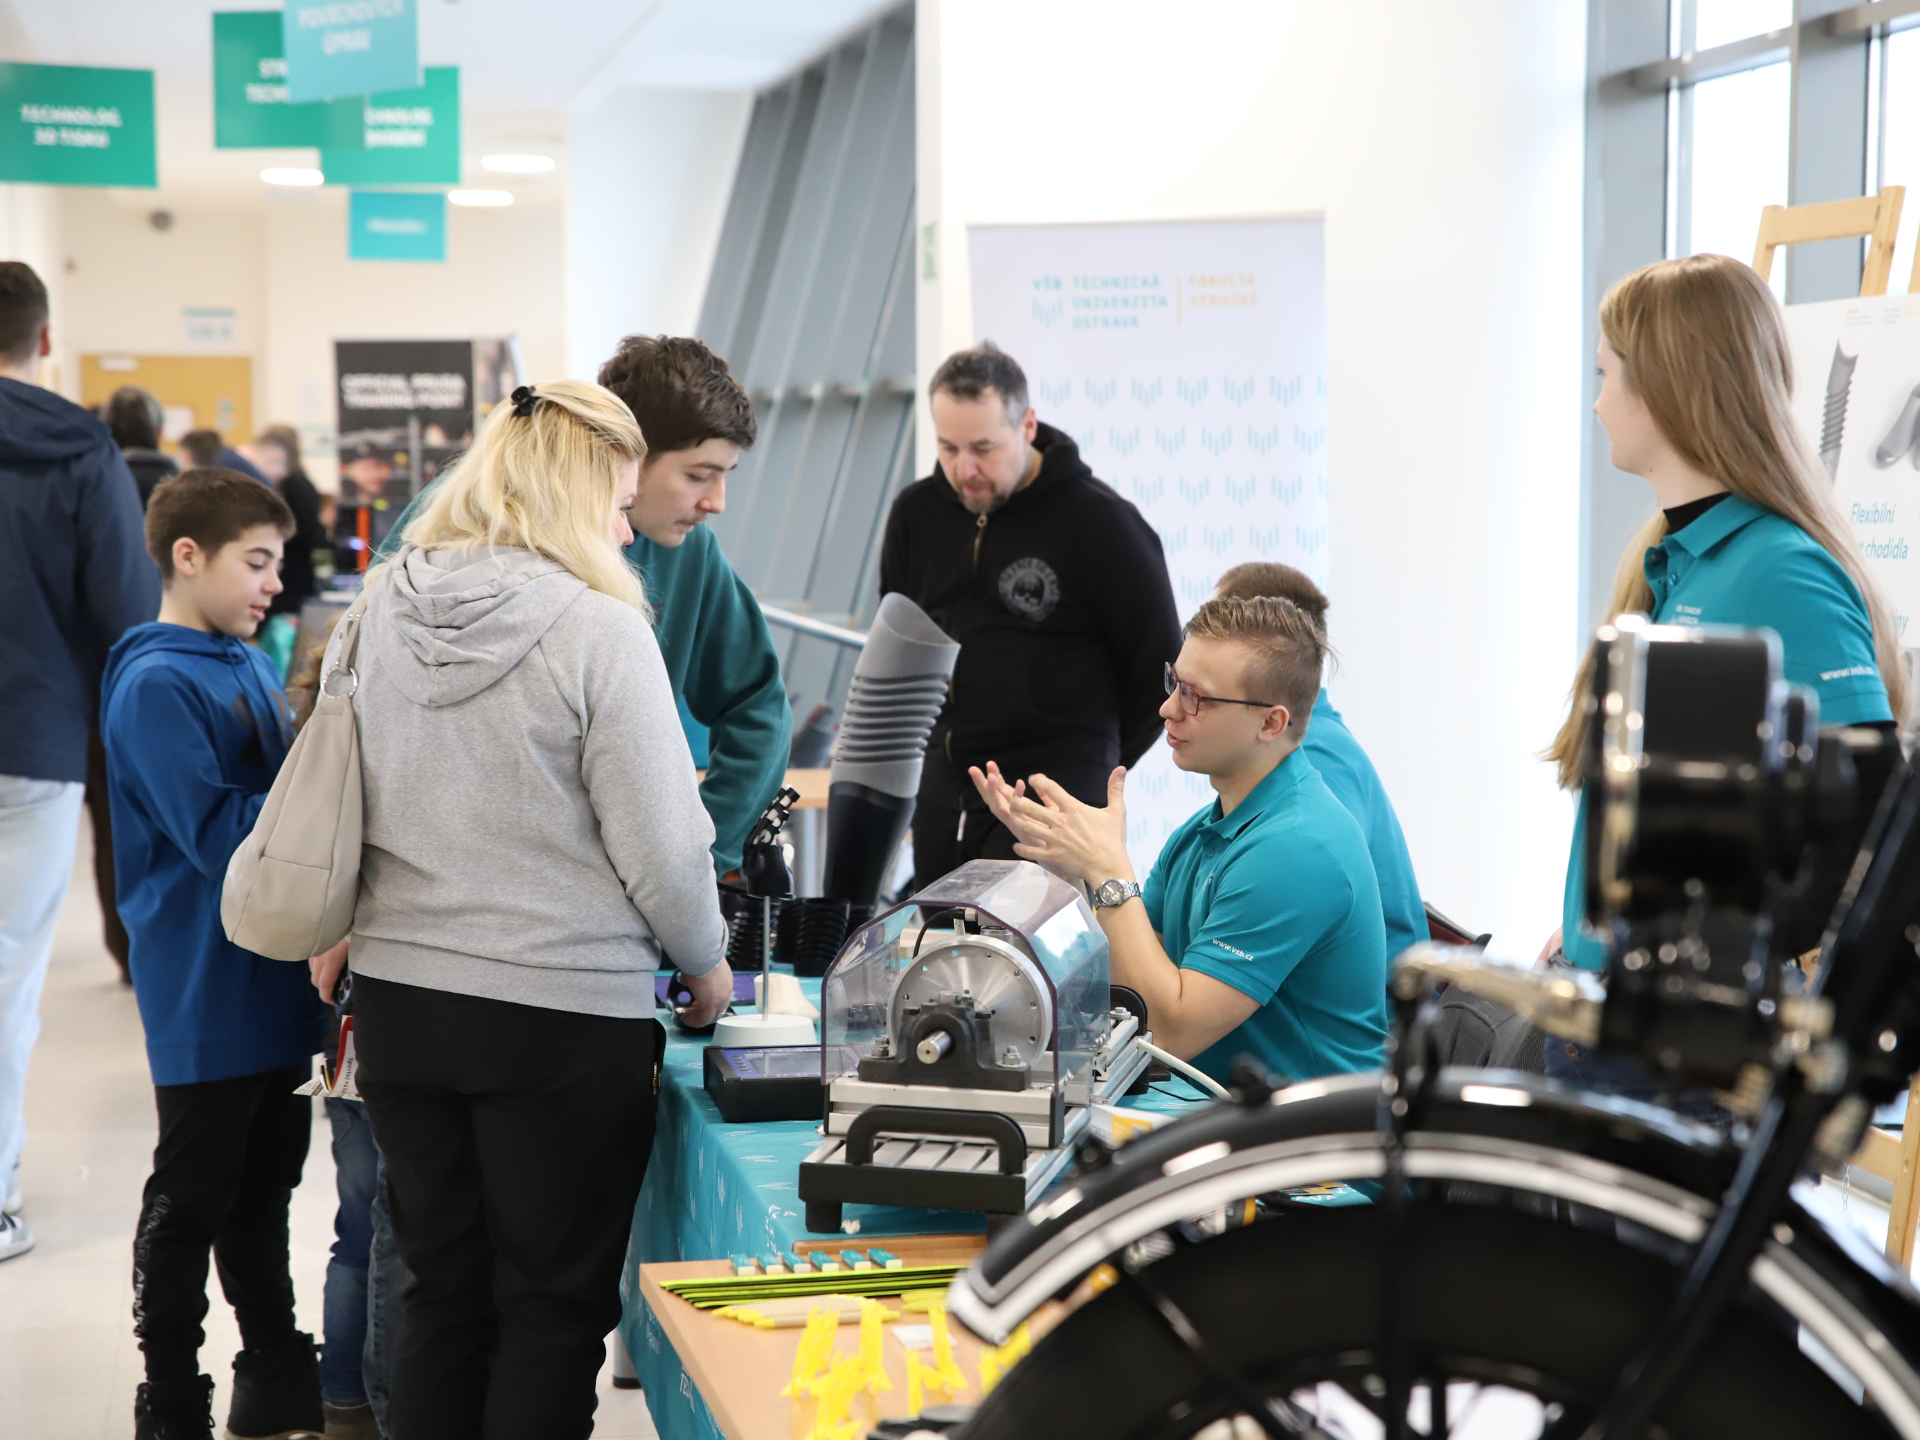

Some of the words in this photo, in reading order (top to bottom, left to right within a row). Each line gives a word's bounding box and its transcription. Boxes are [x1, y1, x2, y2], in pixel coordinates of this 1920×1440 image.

[1032, 275, 1062, 290] VŠB
[1072, 274, 1161, 290] TECHNICKÁ
[1189, 274, 1256, 288] FAKULTA
[1072, 296, 1168, 309] UNIVERZITA
[1190, 291, 1258, 308] STROJNÍ
[1072, 316, 1140, 329] OSTRAVA
[1850, 502, 1897, 524] Flexibilní
[1866, 536, 1909, 560] chodidla
[1212, 938, 1254, 961] www.vsb.cz
